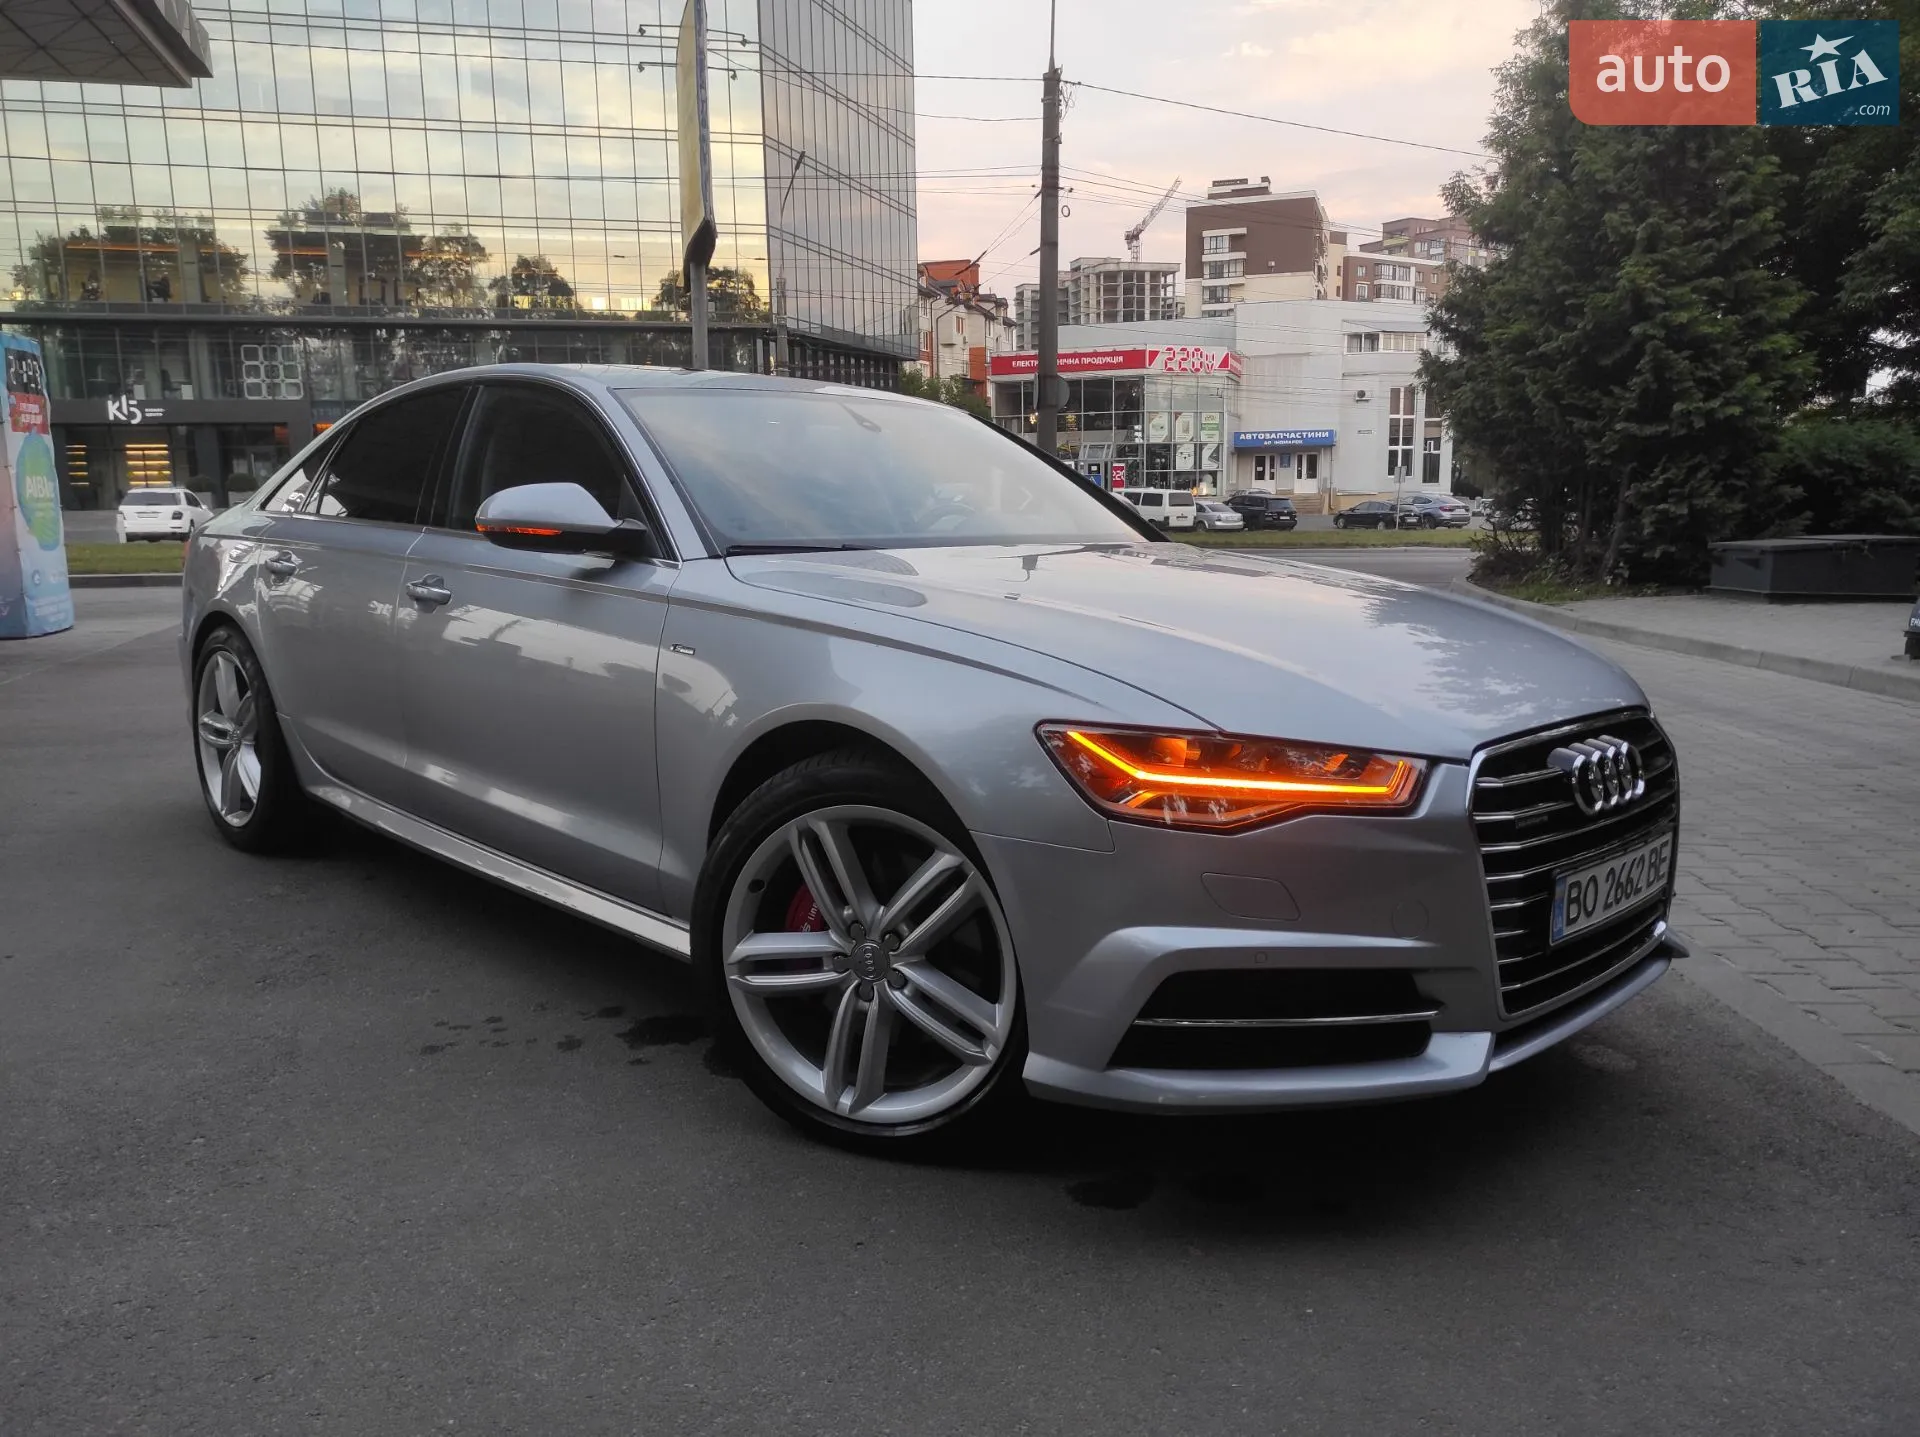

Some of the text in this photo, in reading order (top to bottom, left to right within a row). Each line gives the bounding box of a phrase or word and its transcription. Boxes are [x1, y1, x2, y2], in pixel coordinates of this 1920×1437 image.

[1012, 355, 1124, 368] ЕЛЕКТРНІЧНА ПРОДУКЦІЯ
[1239, 431, 1329, 440] АВТОЗАПЧАСТИНИ
[1566, 840, 1670, 927] BO 2662 BE
